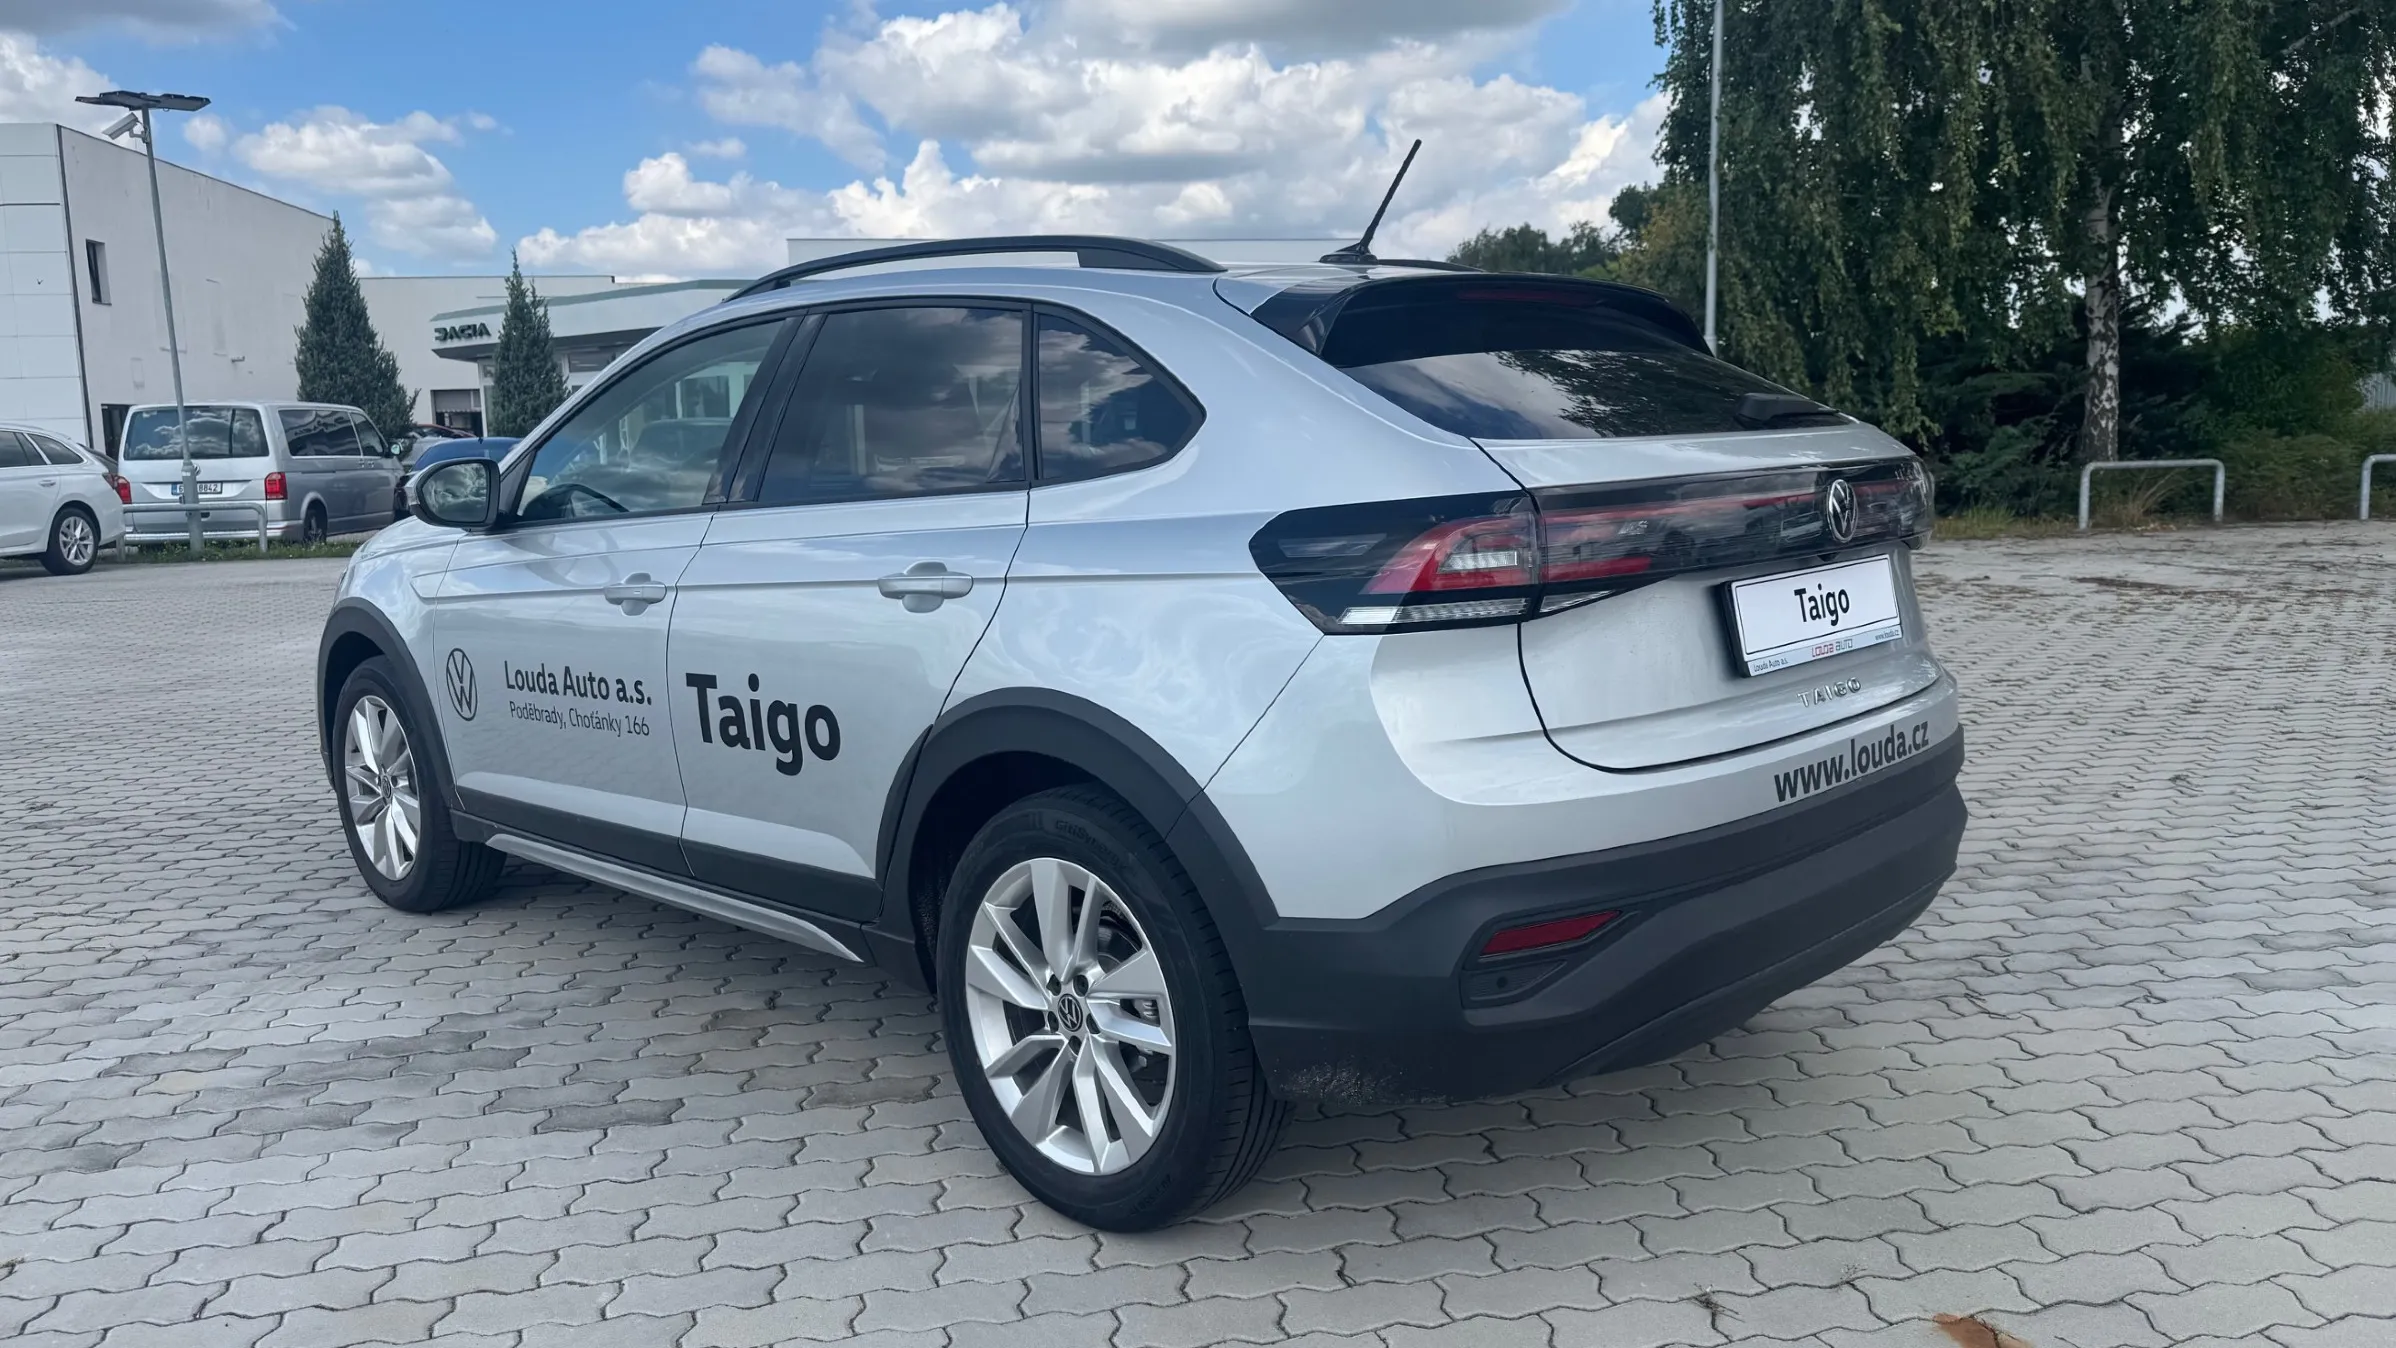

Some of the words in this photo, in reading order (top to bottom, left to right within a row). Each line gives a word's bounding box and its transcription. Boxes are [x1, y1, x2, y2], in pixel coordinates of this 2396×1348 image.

[434, 322, 491, 341] DACIA
[1794, 583, 1850, 626] Taigo
[504, 660, 559, 696] Louda
[563, 665, 610, 700] Auto
[616, 679, 652, 705] a.s.
[1797, 676, 1862, 708] TAIGO
[509, 701, 567, 729] Poděbrady,
[569, 709, 622, 737] Choťánky
[624, 715, 650, 737] 166
[686, 672, 841, 776] Taigo
[1774, 720, 1929, 802] www.louda.cz
